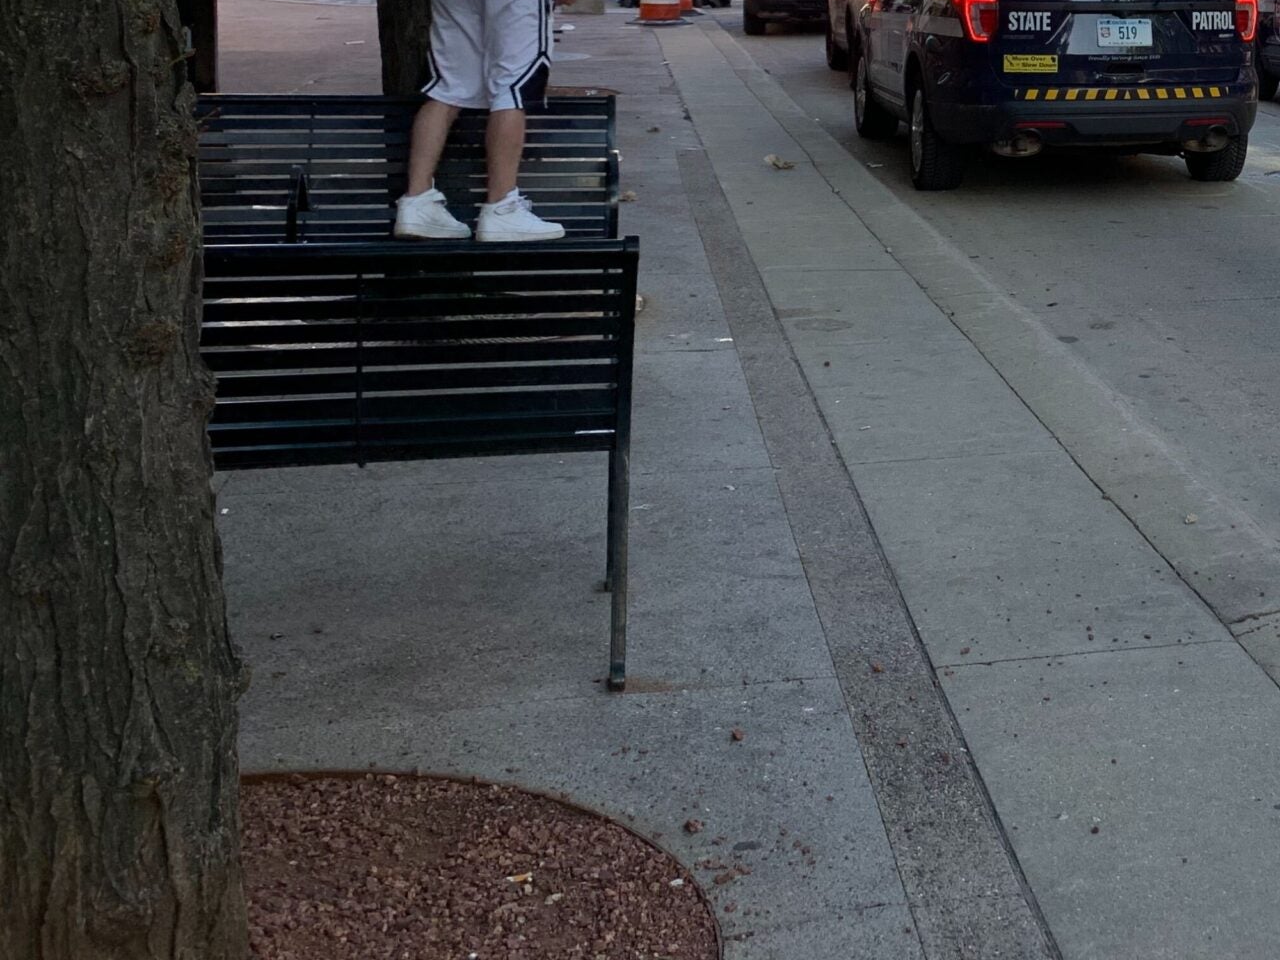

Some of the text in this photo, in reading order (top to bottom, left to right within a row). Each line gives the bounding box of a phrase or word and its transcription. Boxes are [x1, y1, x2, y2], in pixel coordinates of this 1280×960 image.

[1008, 11, 1235, 32] STATE PATROL
[1118, 26, 1138, 41] 519
